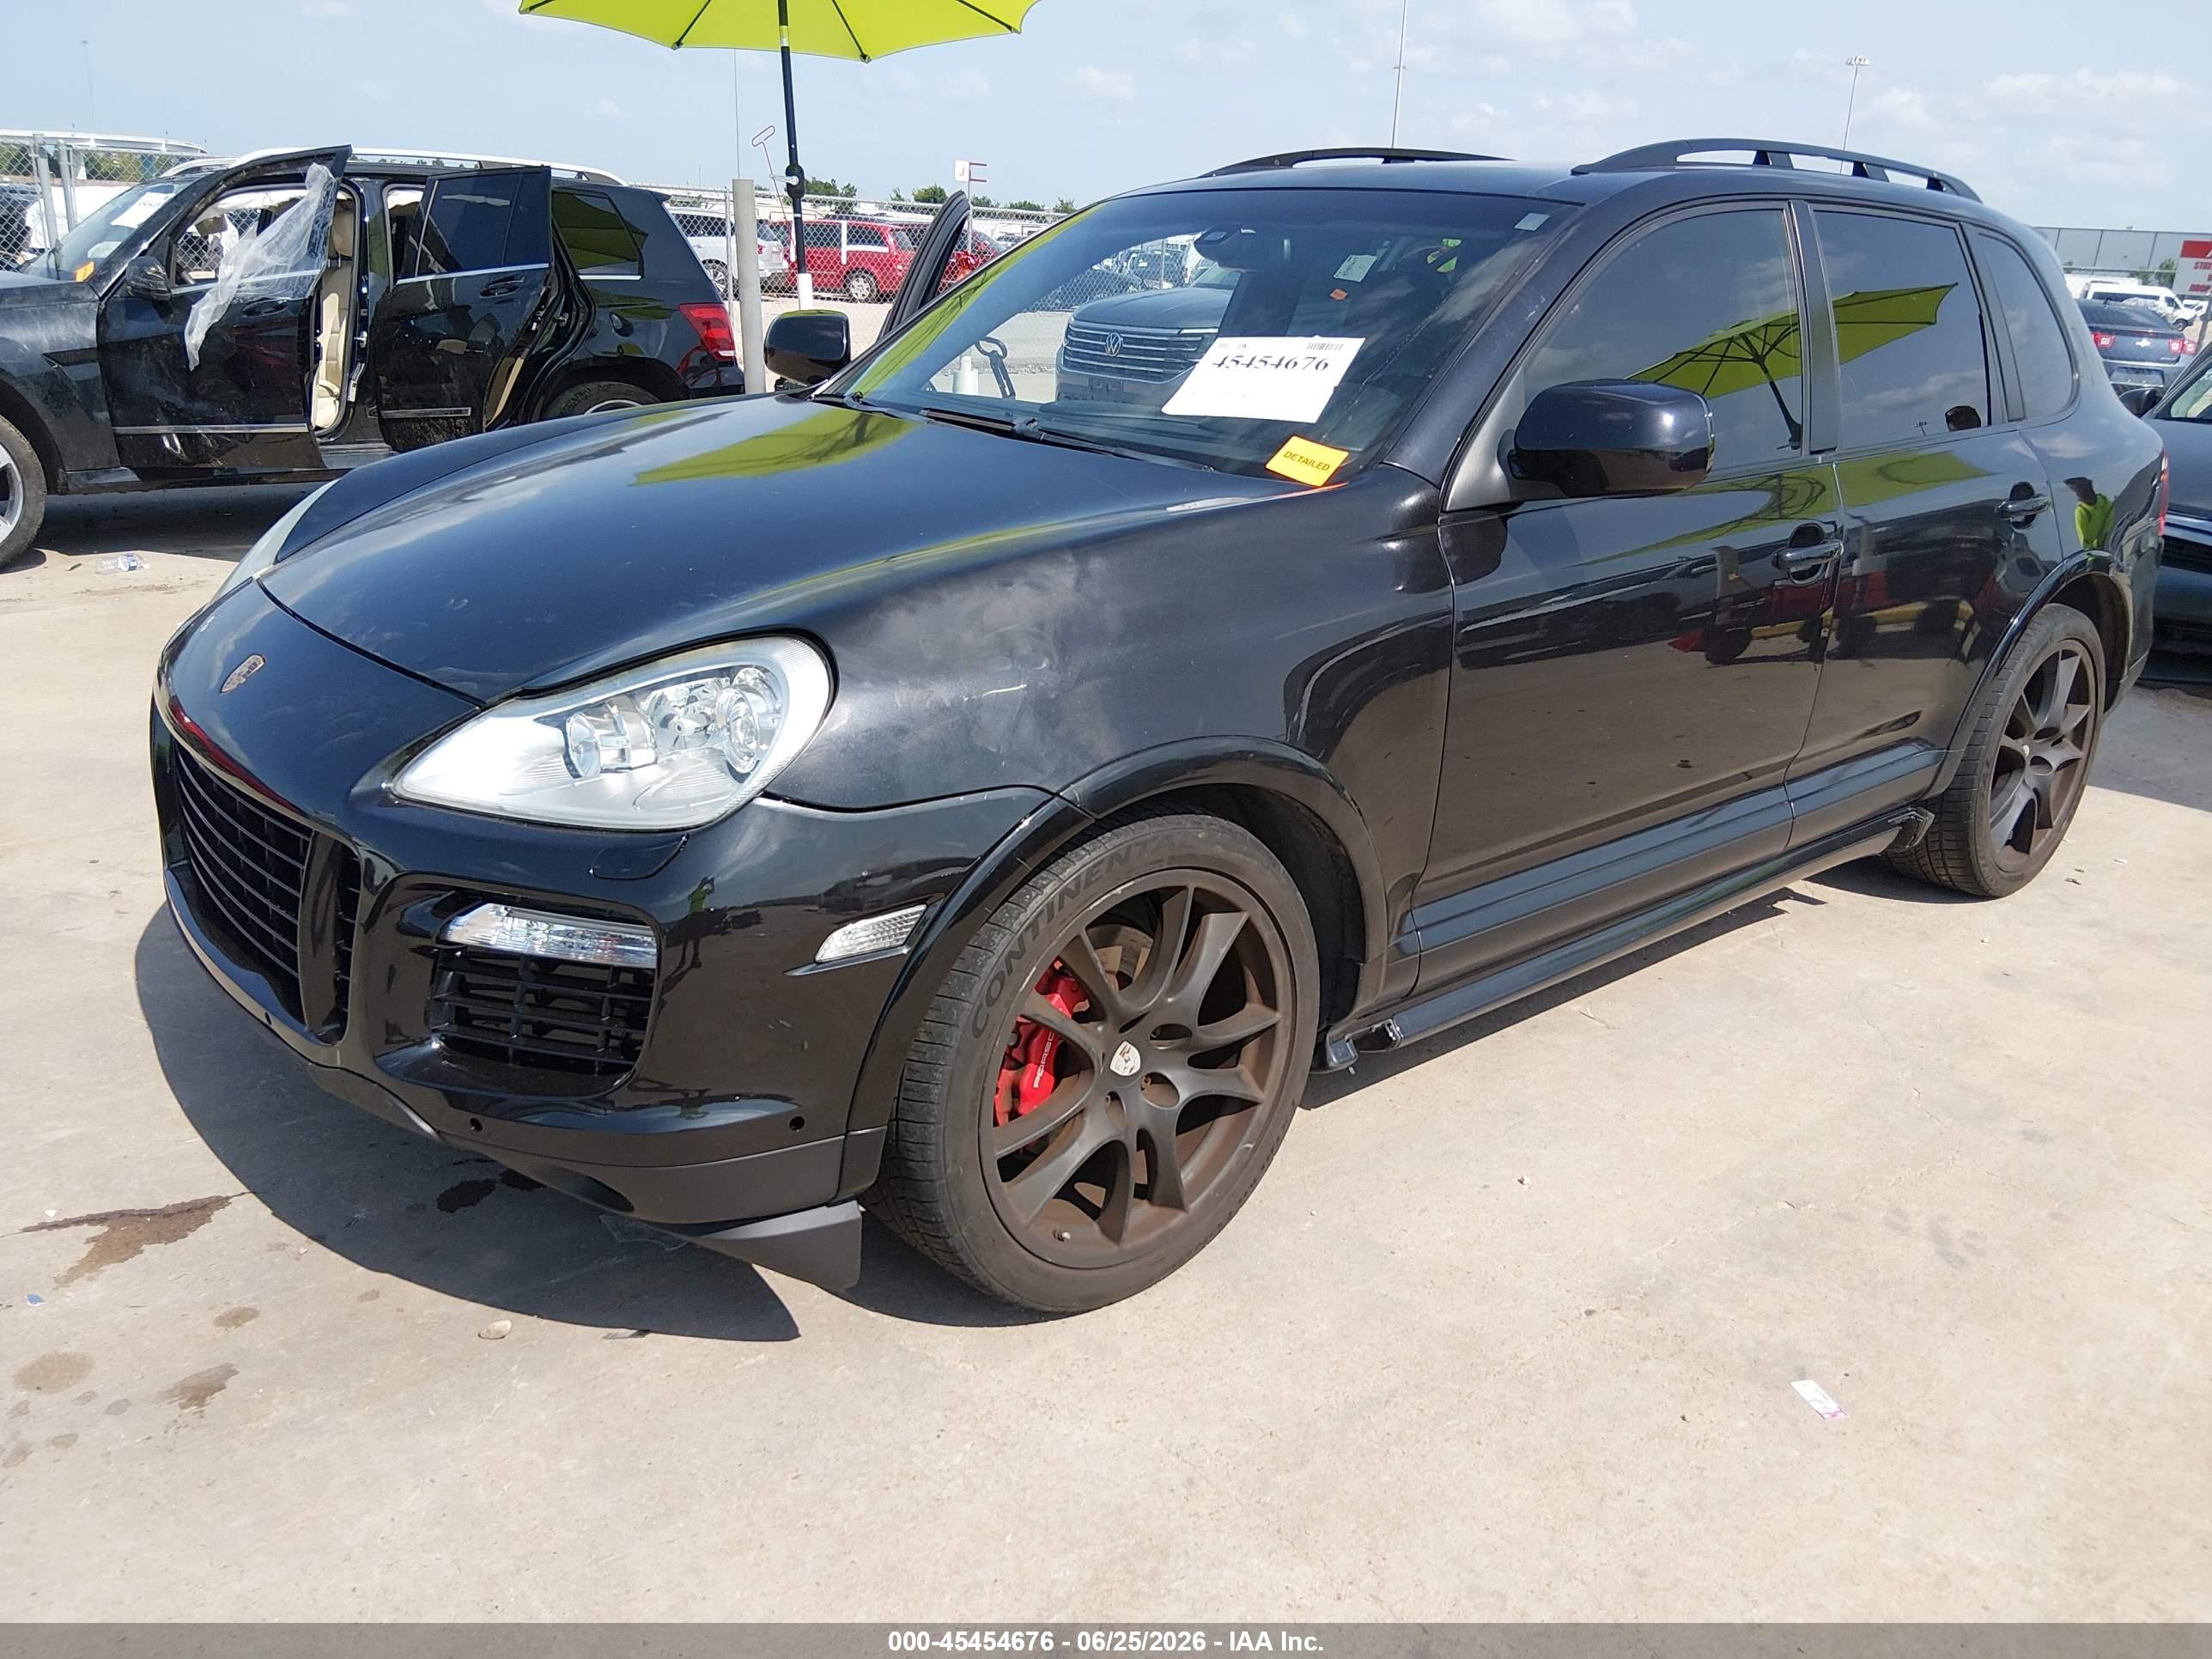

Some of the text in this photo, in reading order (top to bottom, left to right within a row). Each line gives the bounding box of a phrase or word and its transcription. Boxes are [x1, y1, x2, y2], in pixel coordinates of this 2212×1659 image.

[1212, 355, 1330, 371] 45454676
[1283, 451, 1331, 471] DETAILED
[1033, 1030, 1054, 1089] PORSC
